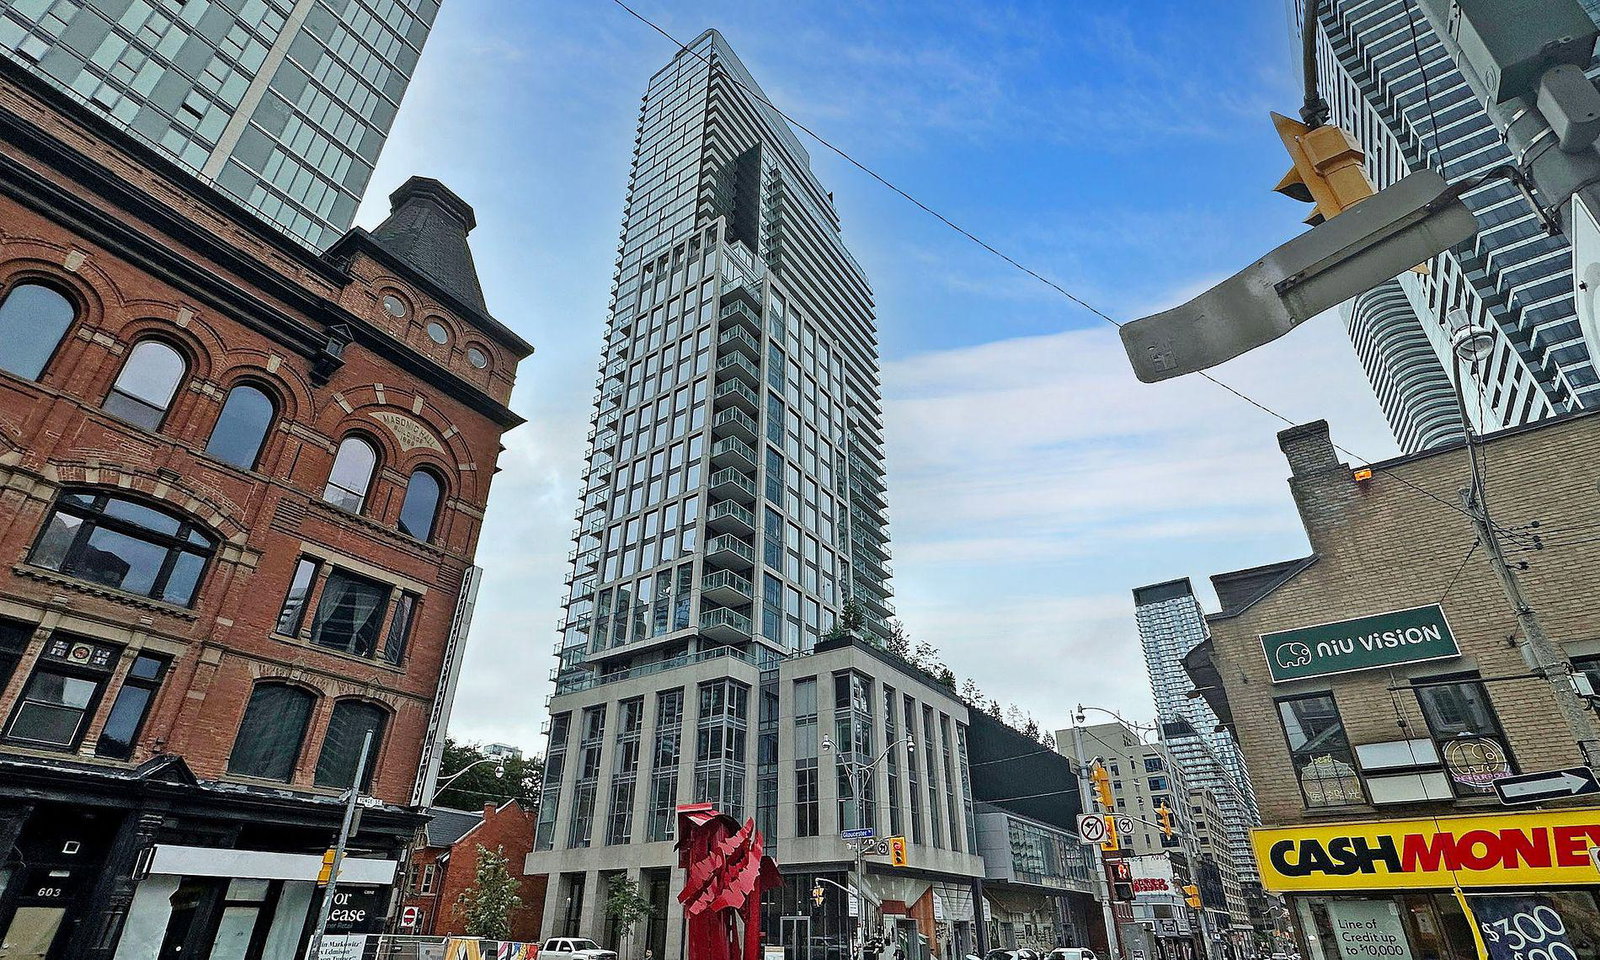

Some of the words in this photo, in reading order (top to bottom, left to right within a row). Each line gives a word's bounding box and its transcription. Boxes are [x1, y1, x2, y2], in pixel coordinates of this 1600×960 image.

[382, 414, 420, 432] MASONIC
[37, 887, 62, 897] 603
[326, 908, 366, 922] ease
[1337, 919, 1363, 929] Line
[1365, 919, 1377, 929] of
[1481, 905, 1566, 950] $300
[1342, 932, 1379, 942] Credit
[1380, 935, 1397, 945] up
[1346, 946, 1358, 955] to
[1360, 944, 1404, 957] $10,000
